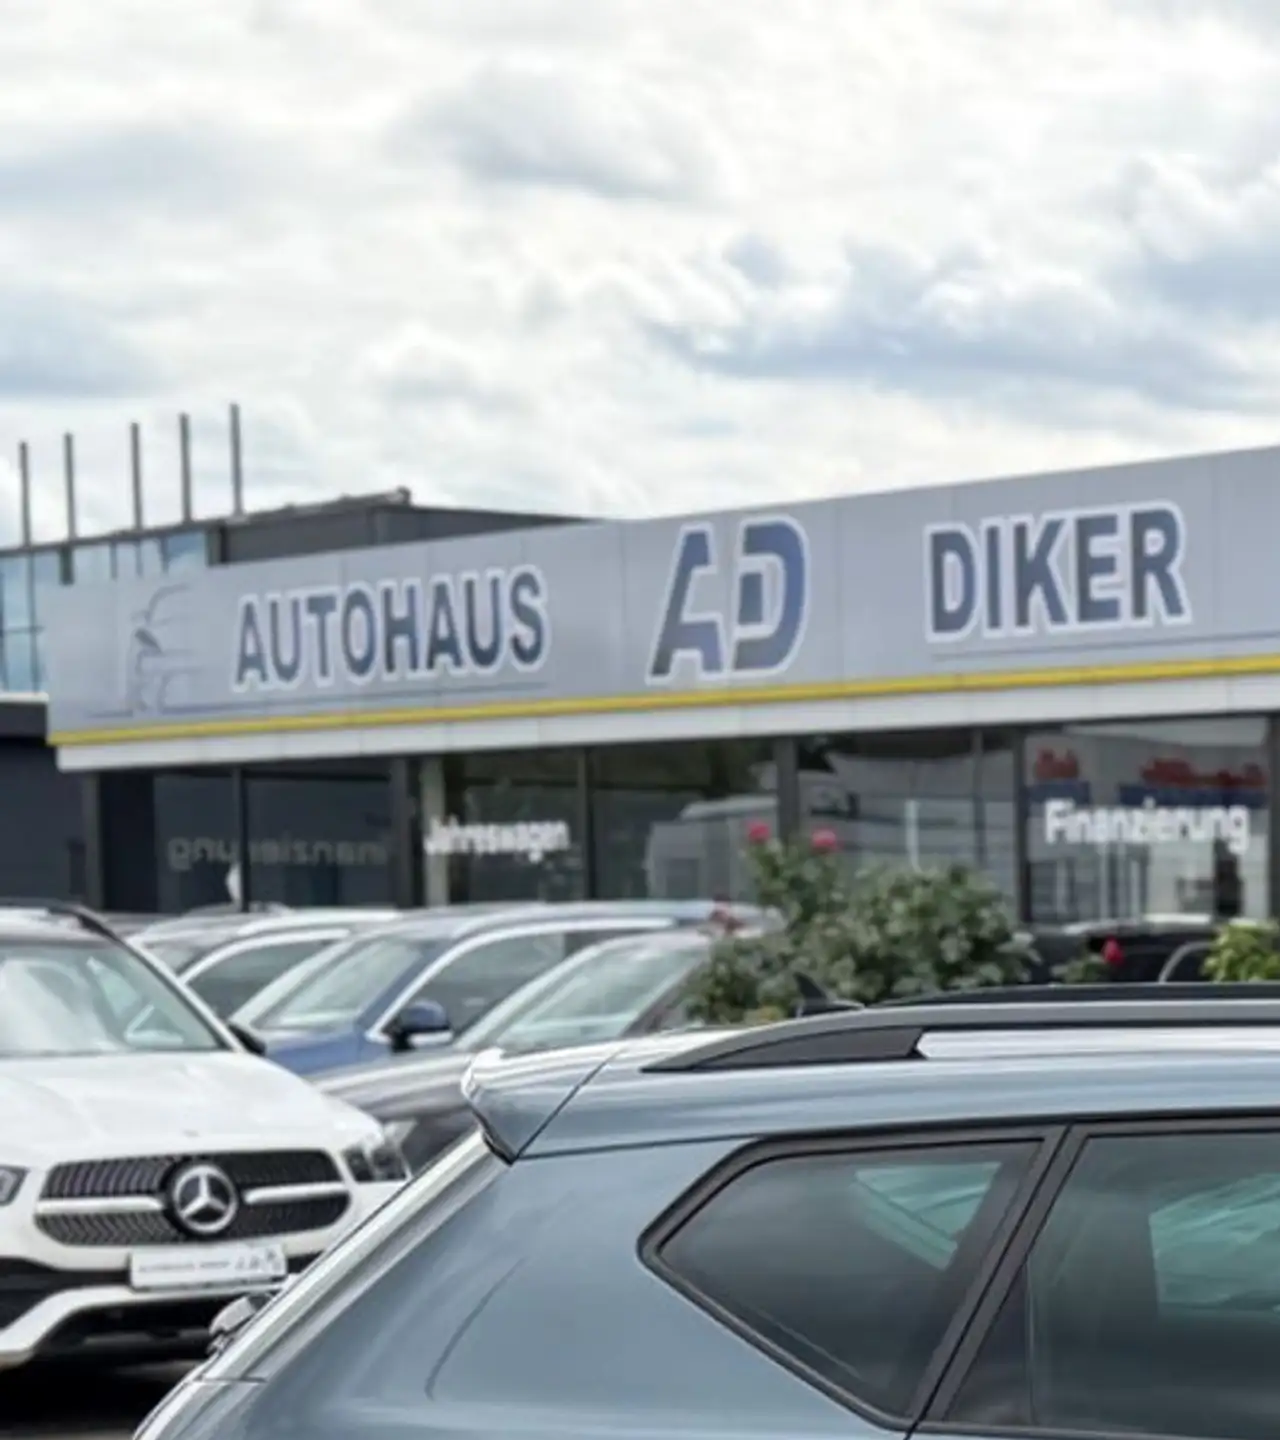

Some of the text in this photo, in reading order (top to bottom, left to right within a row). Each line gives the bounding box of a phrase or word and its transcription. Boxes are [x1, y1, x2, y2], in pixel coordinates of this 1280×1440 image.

[234, 506, 1186, 687] AUTOHAUS AD DIKER
[1045, 797, 1250, 856] Finanzierung
